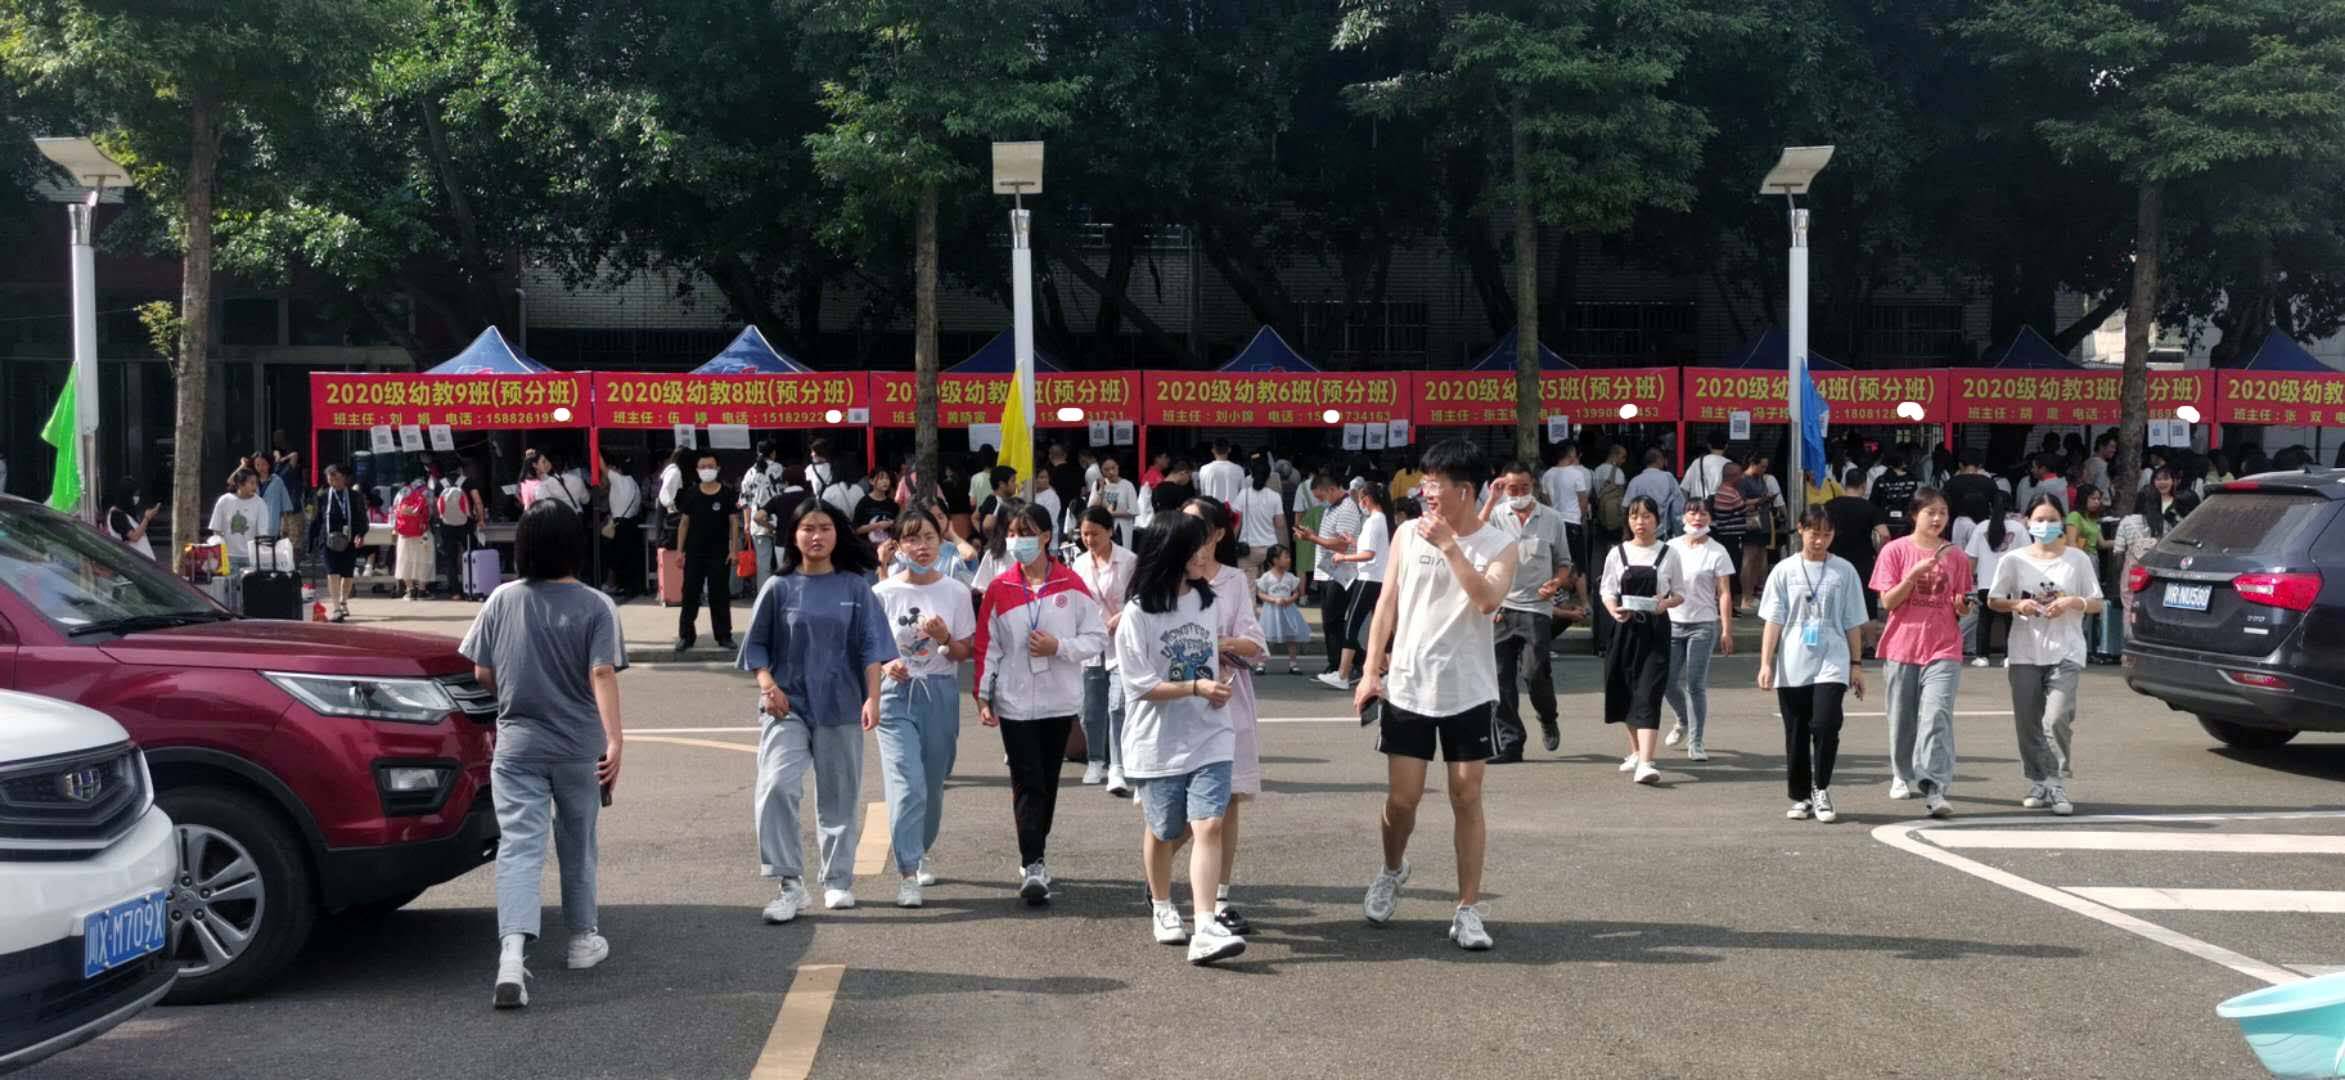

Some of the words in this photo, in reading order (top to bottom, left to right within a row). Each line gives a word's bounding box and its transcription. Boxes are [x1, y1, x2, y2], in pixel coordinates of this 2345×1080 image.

[326, 379, 579, 407] 2020级幼教9班(预分班)
[608, 378, 854, 407] 2020级幼教8班(预分班)
[1157, 378, 1397, 405] 2020级幼教6班(预分班)
[1695, 376, 1935, 403] 2020级幼4班(预分班)
[1962, 376, 2201, 403] 2020级幼教3班(分班)
